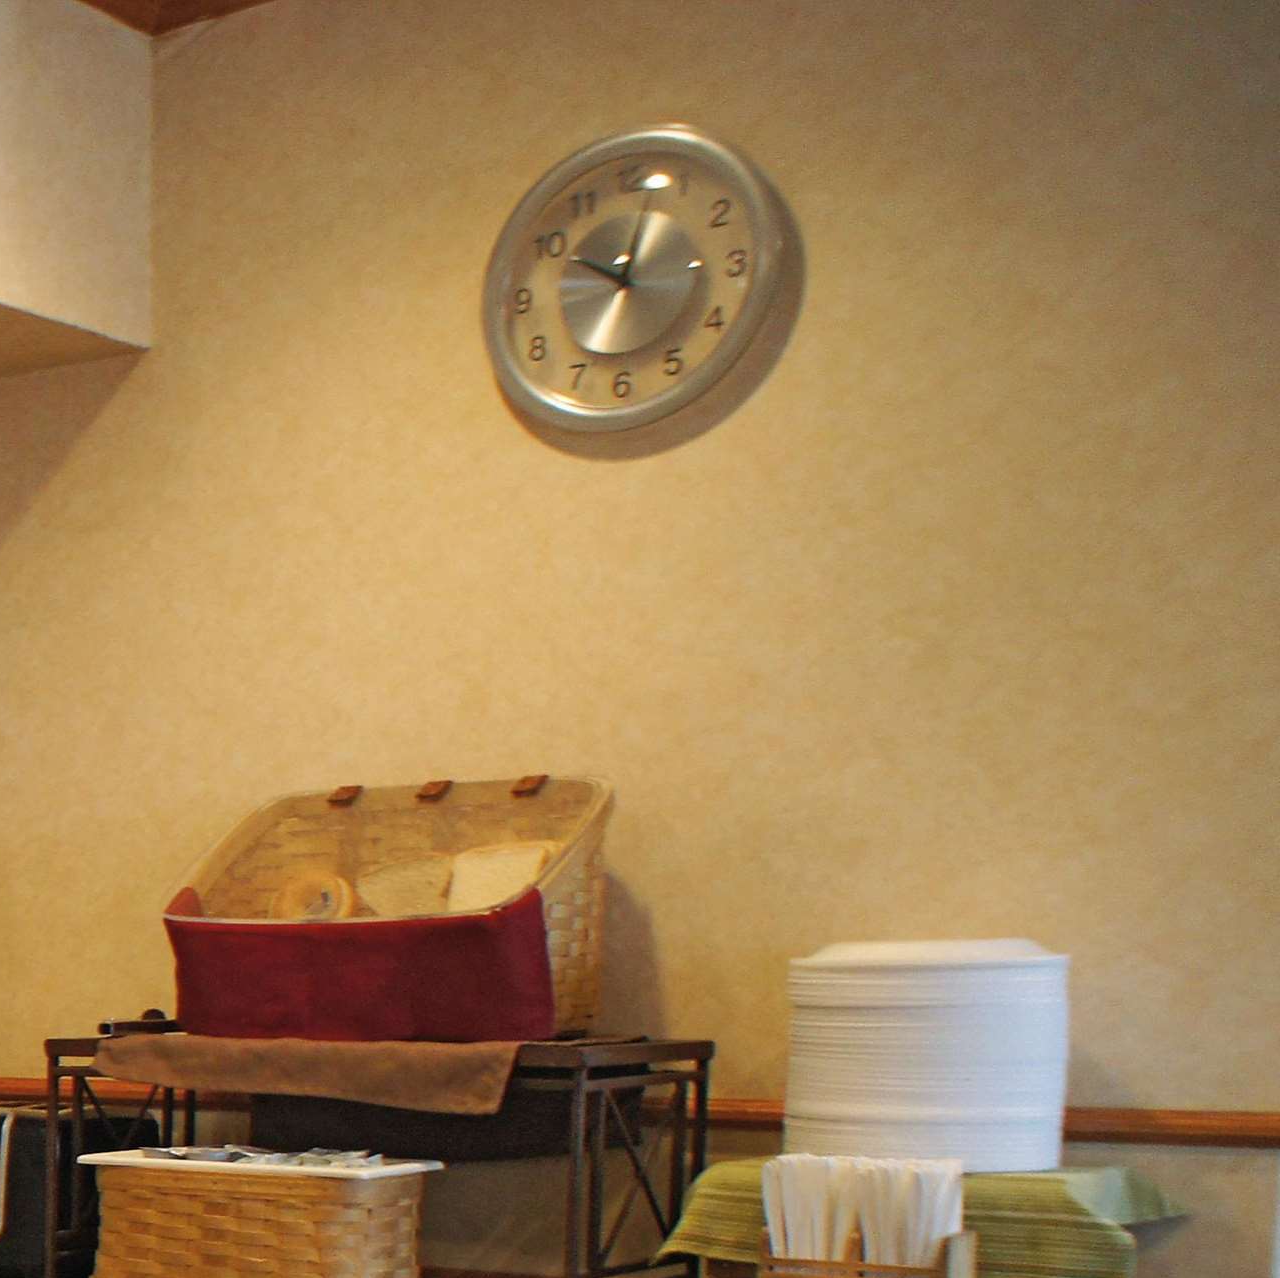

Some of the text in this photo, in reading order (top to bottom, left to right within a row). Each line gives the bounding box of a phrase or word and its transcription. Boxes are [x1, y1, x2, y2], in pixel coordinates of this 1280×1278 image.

[569, 190, 596, 219] 11
[710, 199, 732, 228] 2
[534, 231, 565, 257] 10
[726, 250, 746, 277] 3
[515, 288, 531, 314] 9
[705, 306, 724, 334] 4
[529, 336, 546, 361] 8
[664, 349, 682, 376] 5
[569, 363, 587, 390] 7
[612, 372, 631, 398] 6
